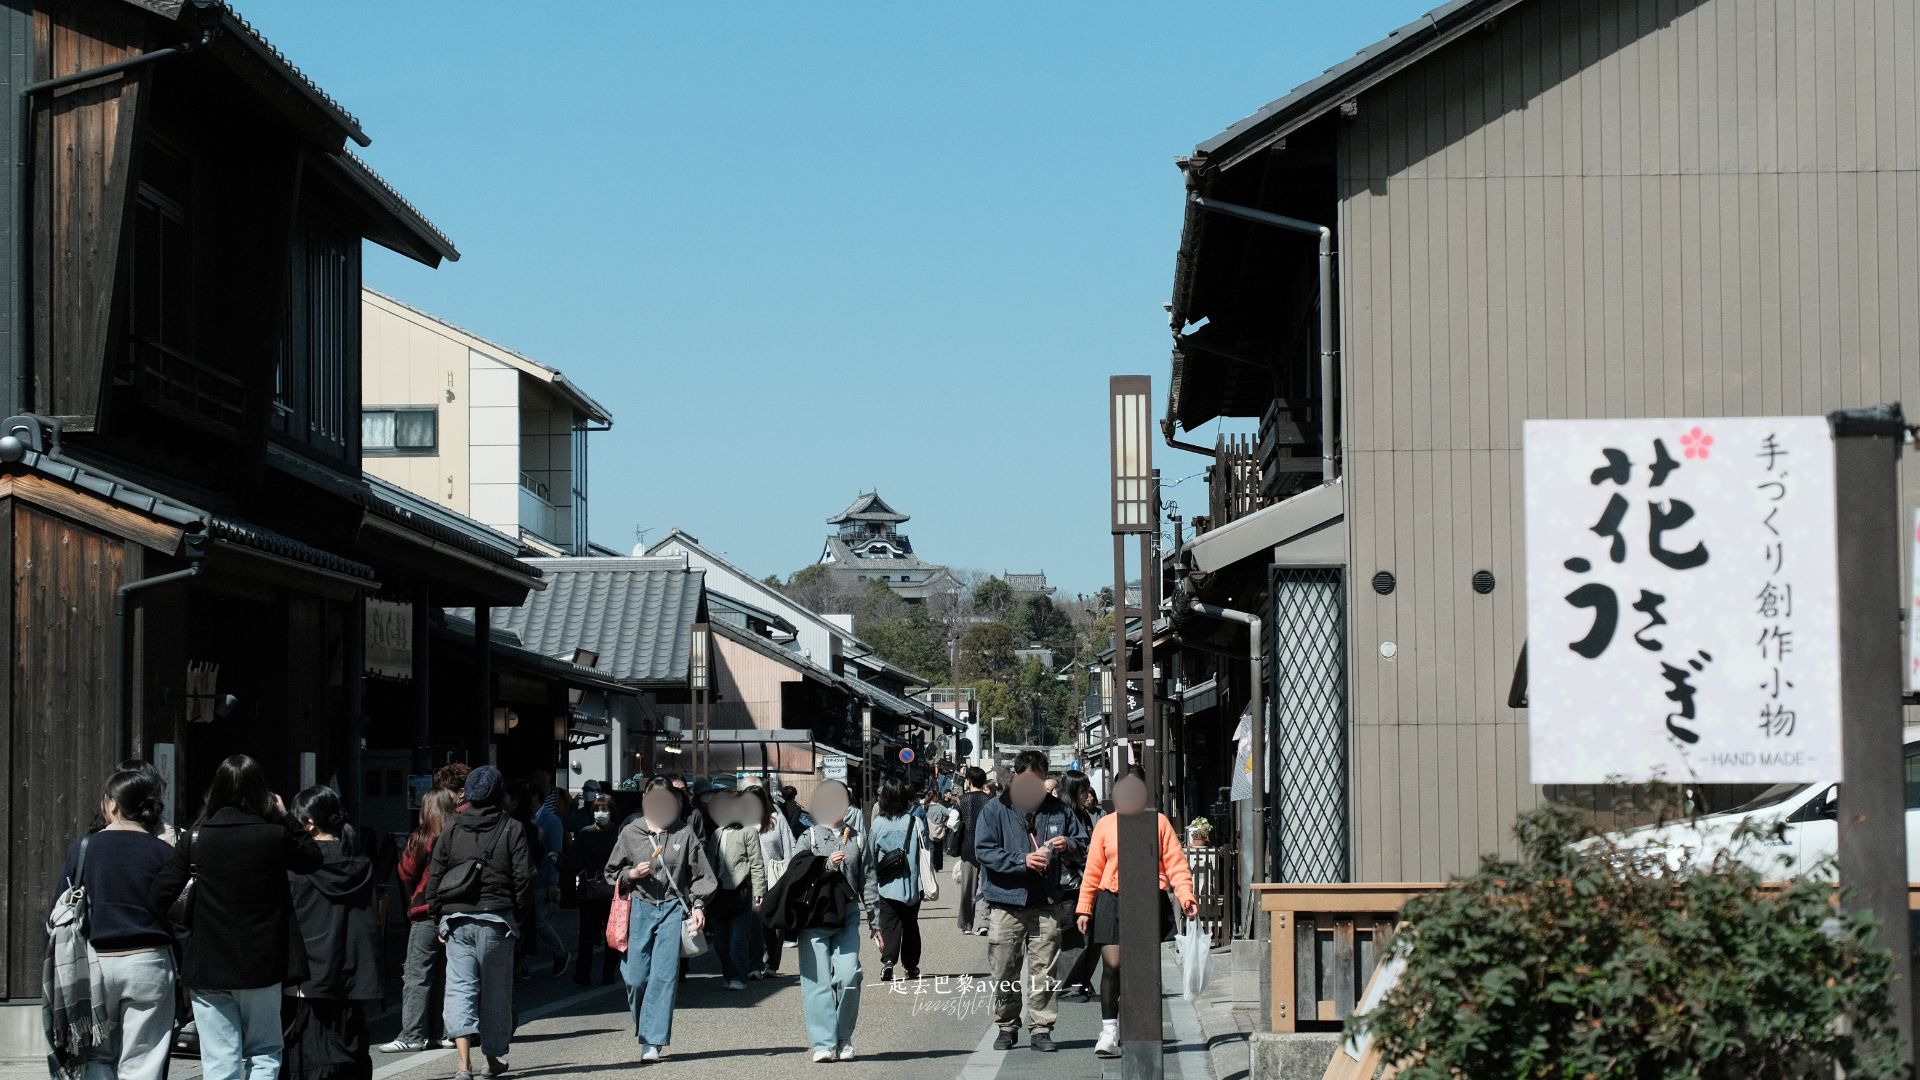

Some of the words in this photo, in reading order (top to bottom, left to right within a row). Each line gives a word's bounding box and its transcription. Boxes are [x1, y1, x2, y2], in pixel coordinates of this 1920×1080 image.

[1755, 432, 1796, 738] 手づくり創作小物
